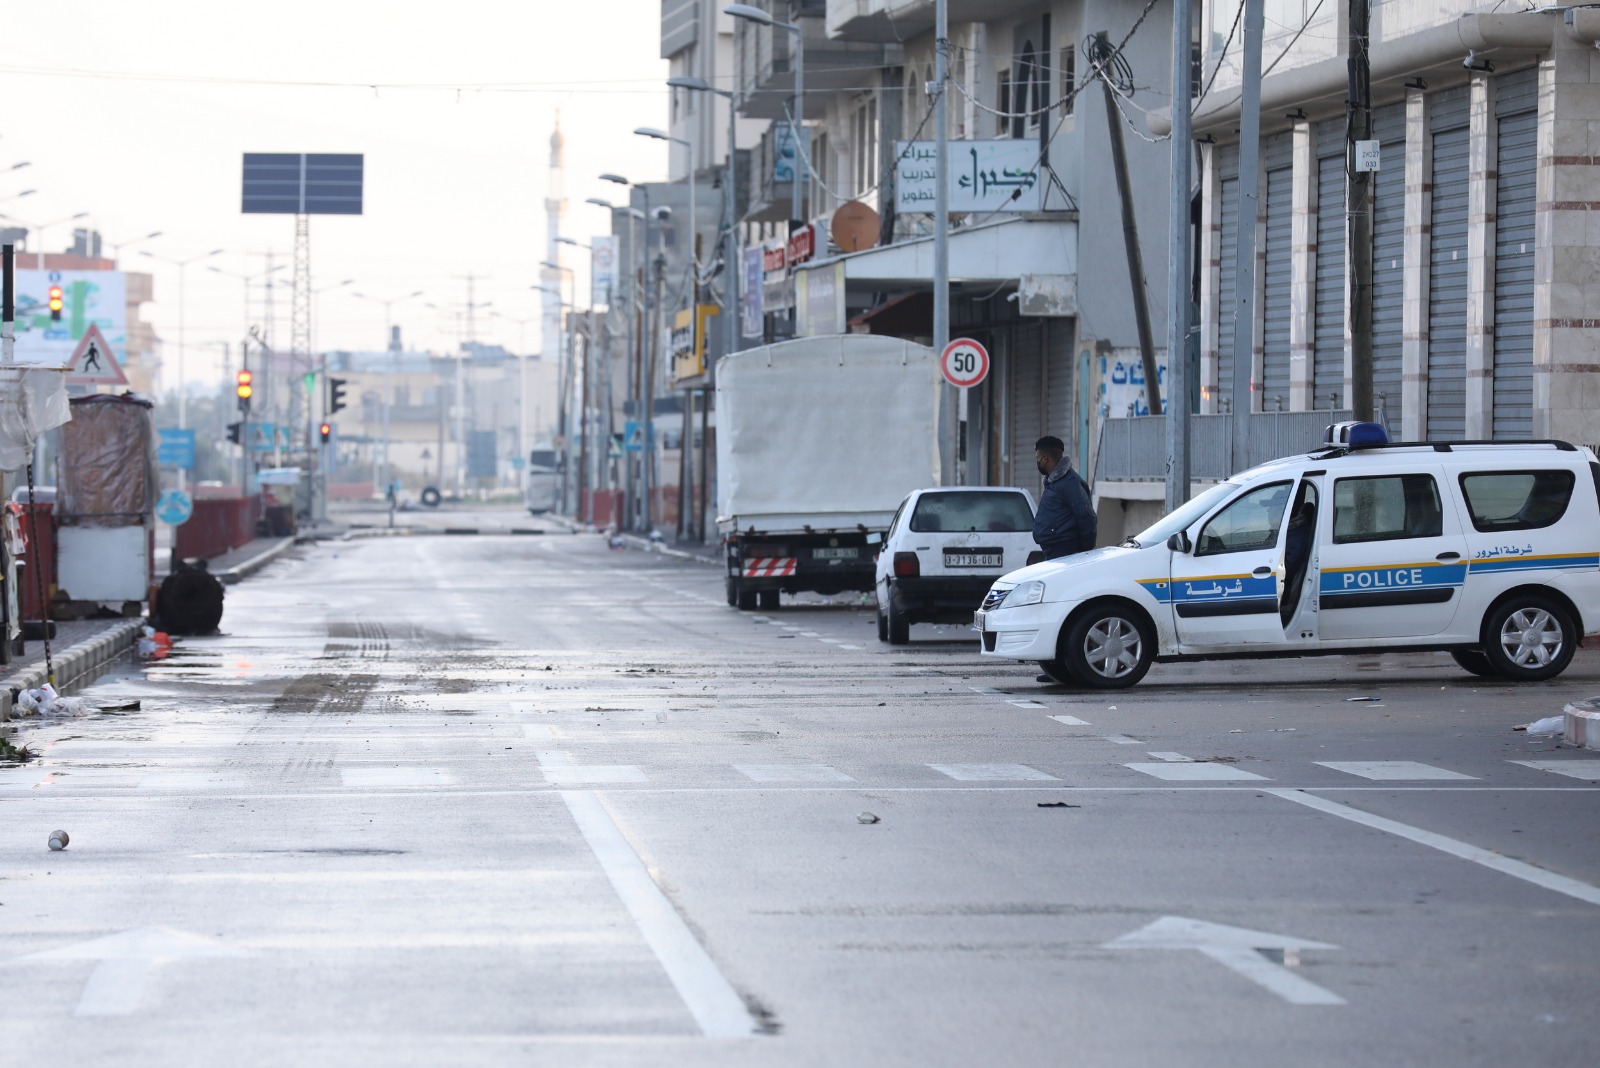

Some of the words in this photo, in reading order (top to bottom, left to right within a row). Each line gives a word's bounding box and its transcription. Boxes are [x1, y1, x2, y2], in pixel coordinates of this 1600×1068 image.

[954, 352, 975, 373] 50
[1475, 546, 1503, 558] المرور
[1503, 543, 1533, 556] شرطة
[1185, 578, 1242, 597] شرطة
[1343, 568, 1423, 588] POLICE
